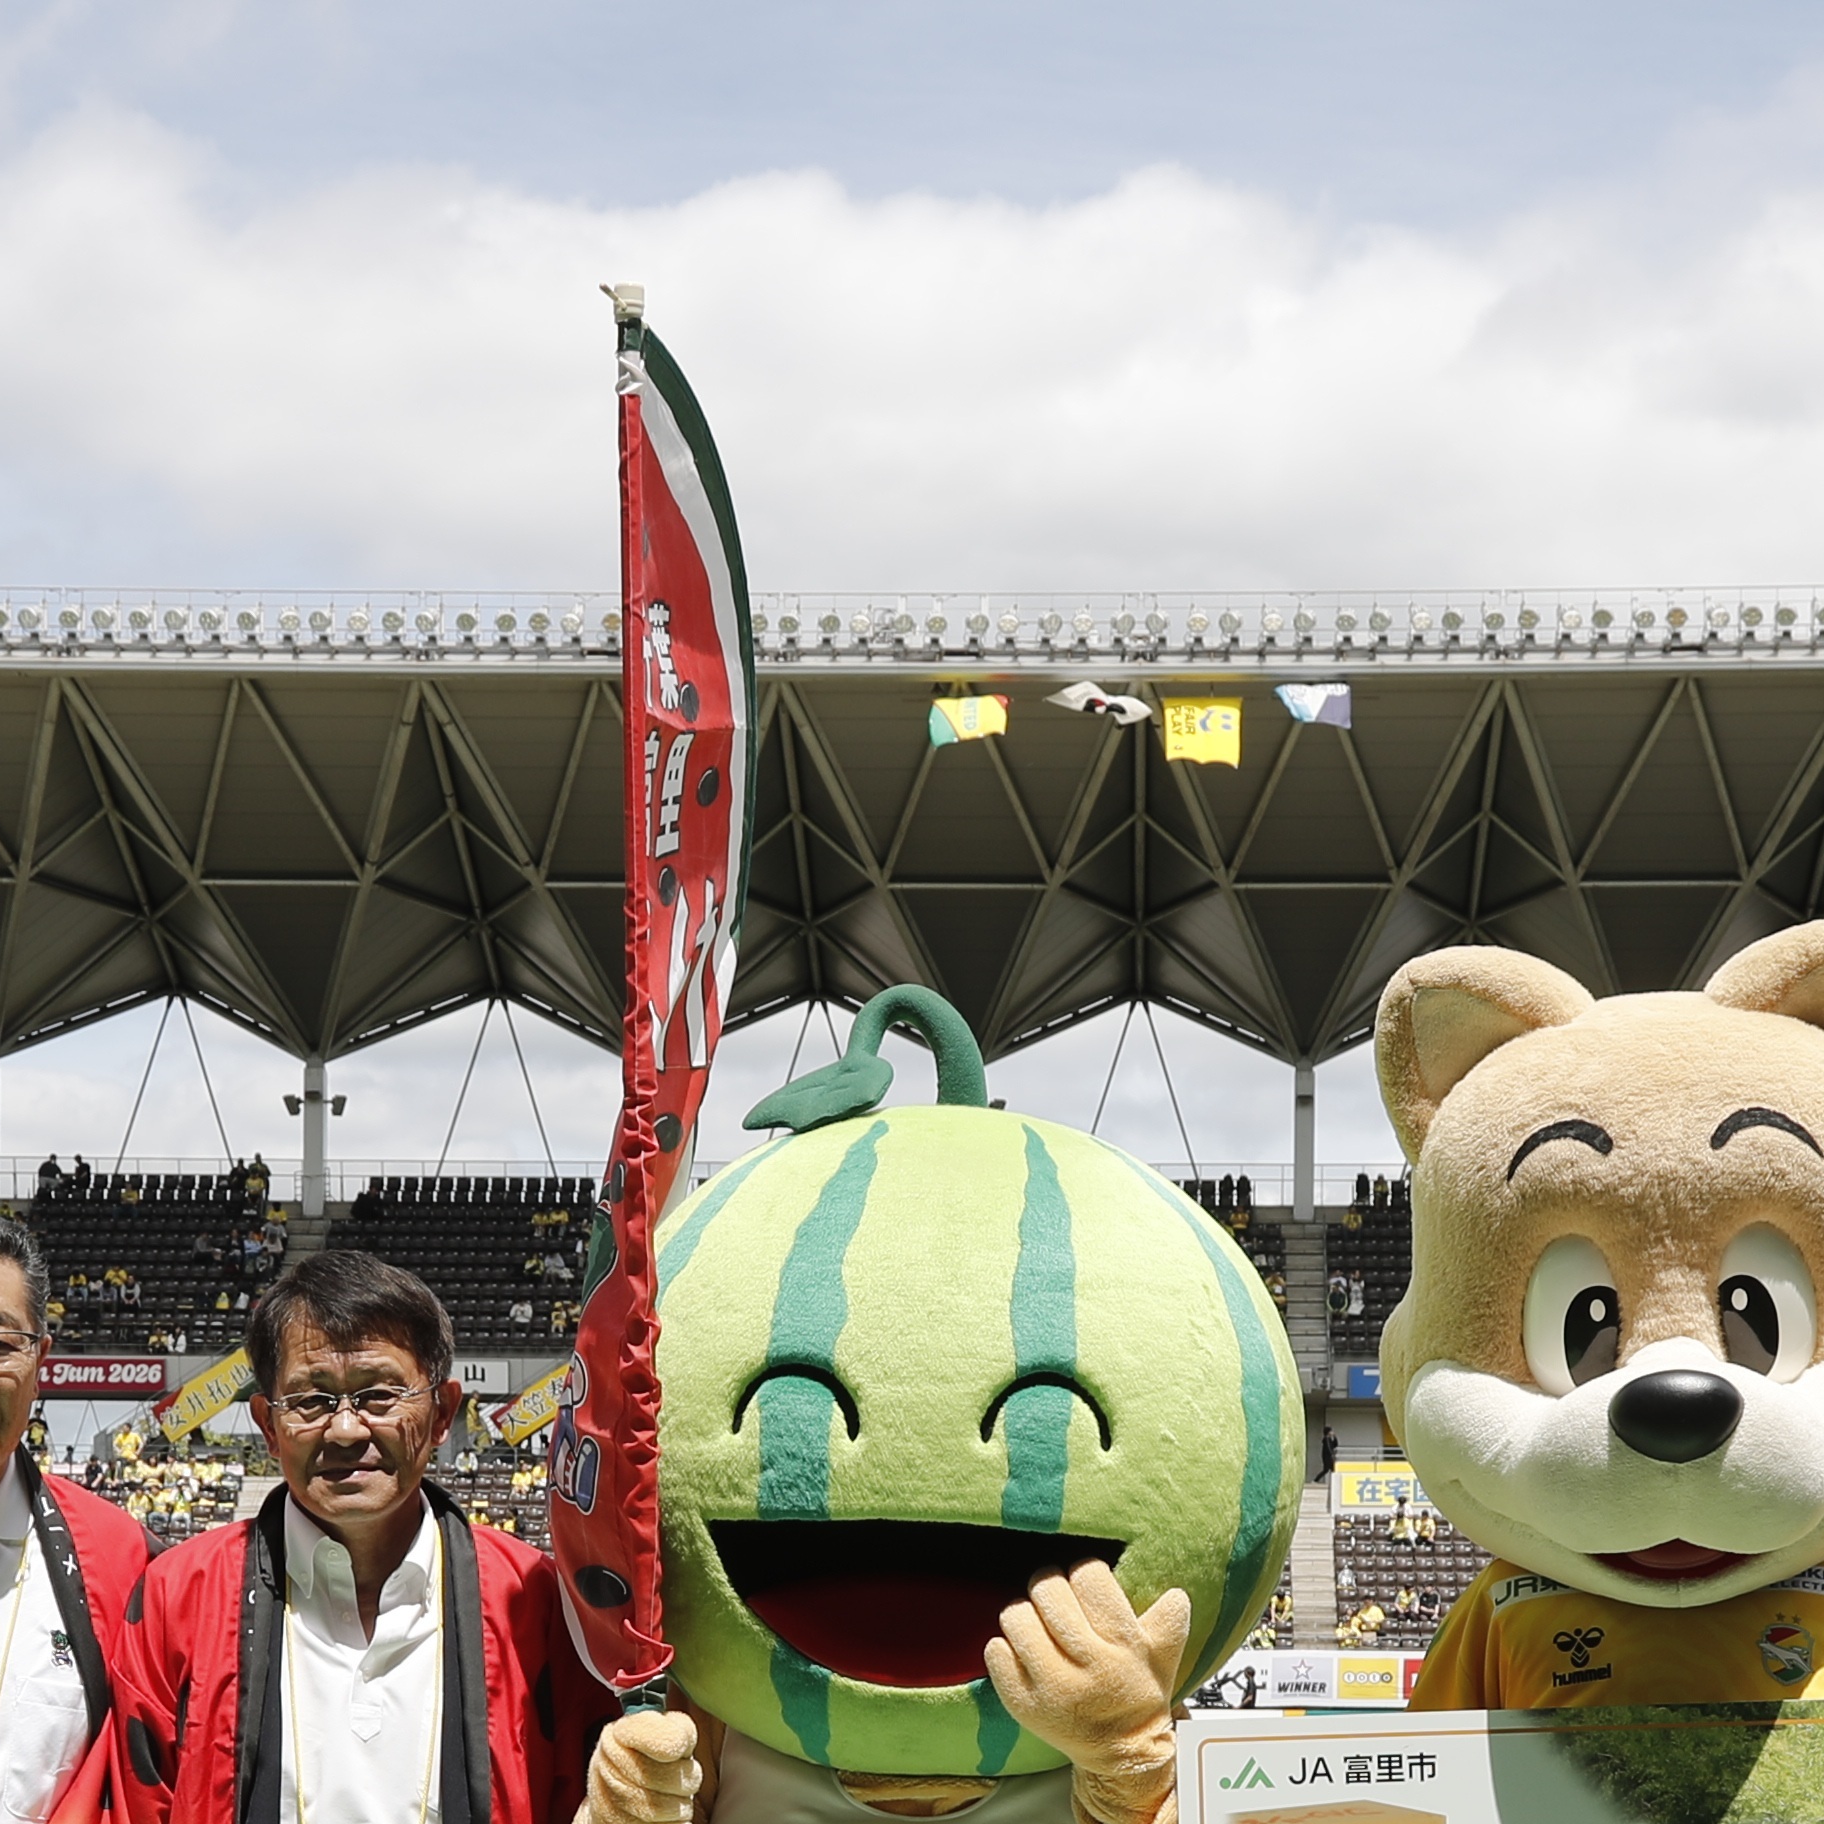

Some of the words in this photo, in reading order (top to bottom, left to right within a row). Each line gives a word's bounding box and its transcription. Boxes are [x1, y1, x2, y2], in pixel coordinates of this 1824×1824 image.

[52, 1363, 106, 1385] Jam
[107, 1363, 162, 1384] 2026
[464, 1363, 486, 1383] 山
[1552, 1663, 1613, 1688] hummel
[1277, 1681, 1327, 1694] WINNER
[1288, 1756, 1334, 1786] JA
[1343, 1751, 1439, 1786] 富里市
